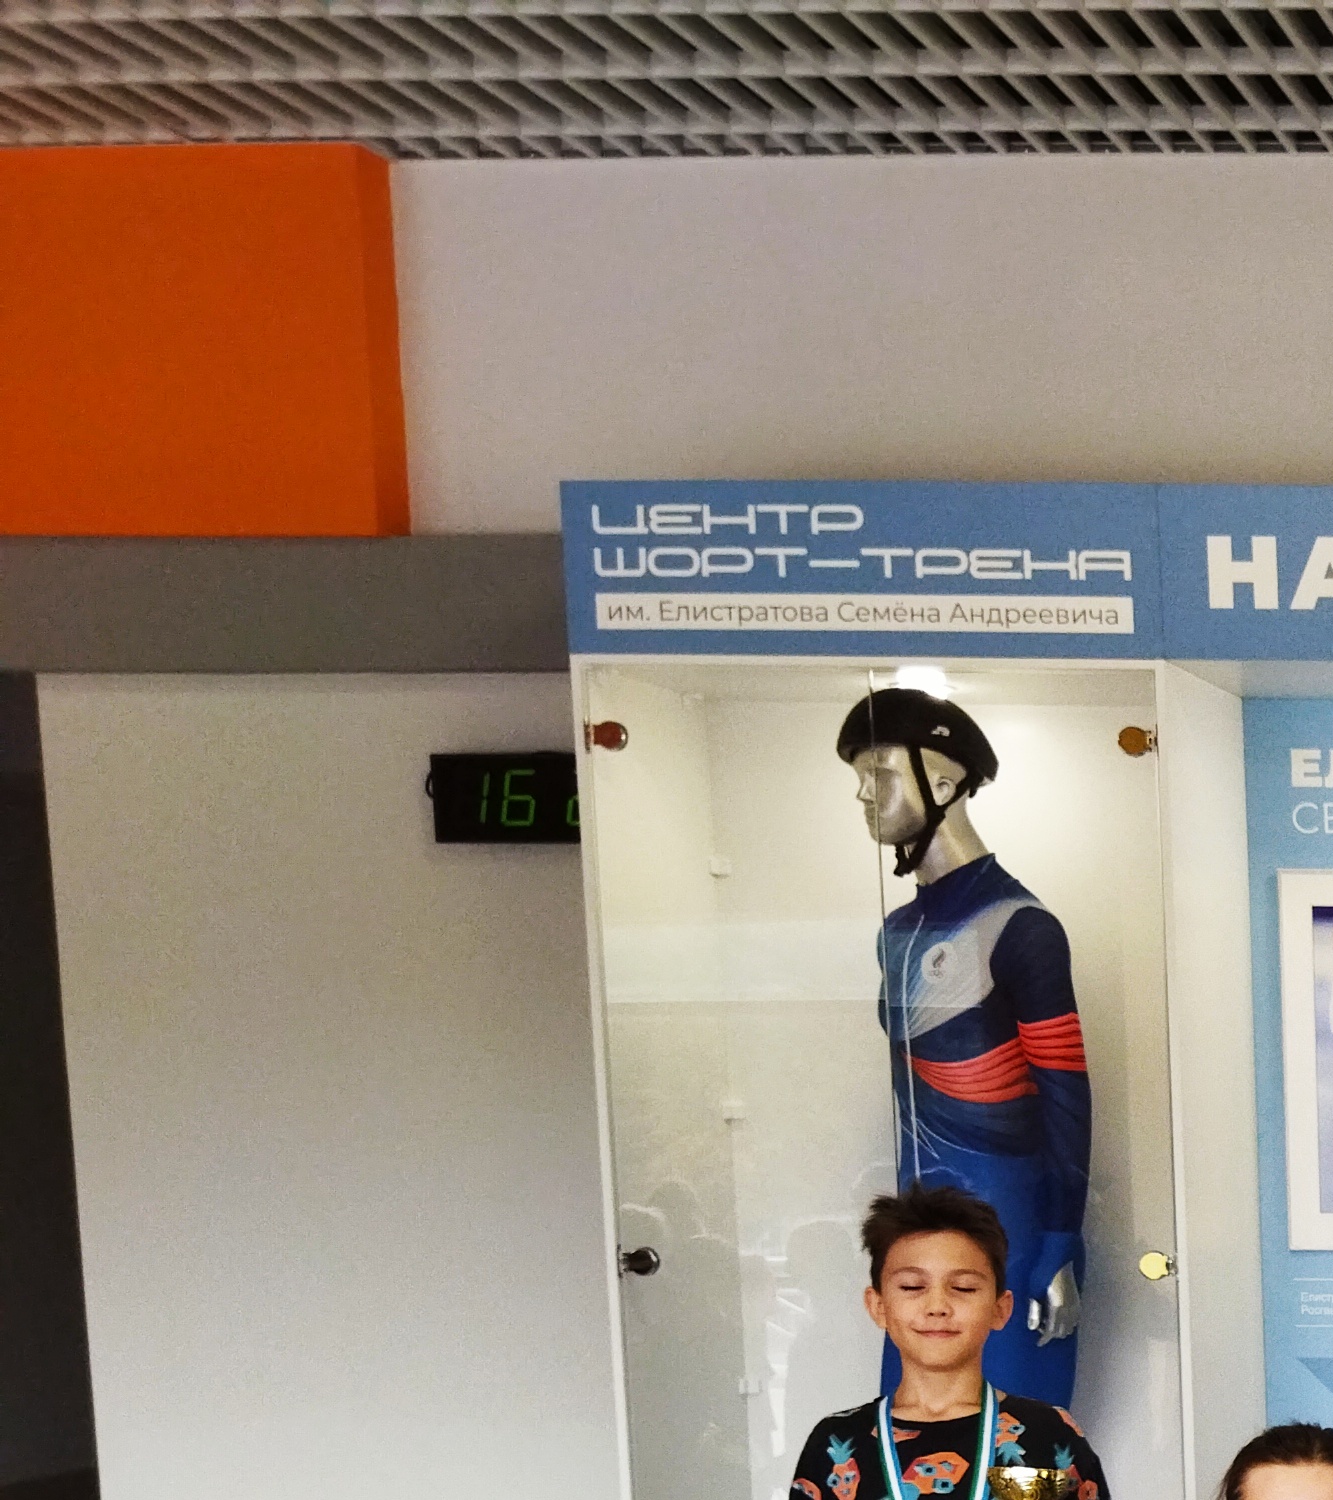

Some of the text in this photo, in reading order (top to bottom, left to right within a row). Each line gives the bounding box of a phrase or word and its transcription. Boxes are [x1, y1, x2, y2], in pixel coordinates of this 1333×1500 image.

[591, 503, 864, 535] ЦЕНТР
[593, 546, 1132, 582] ШОРТ-ТРЕКА
[607, 600, 1119, 630] им. Елистратова Семёна Андреевича
